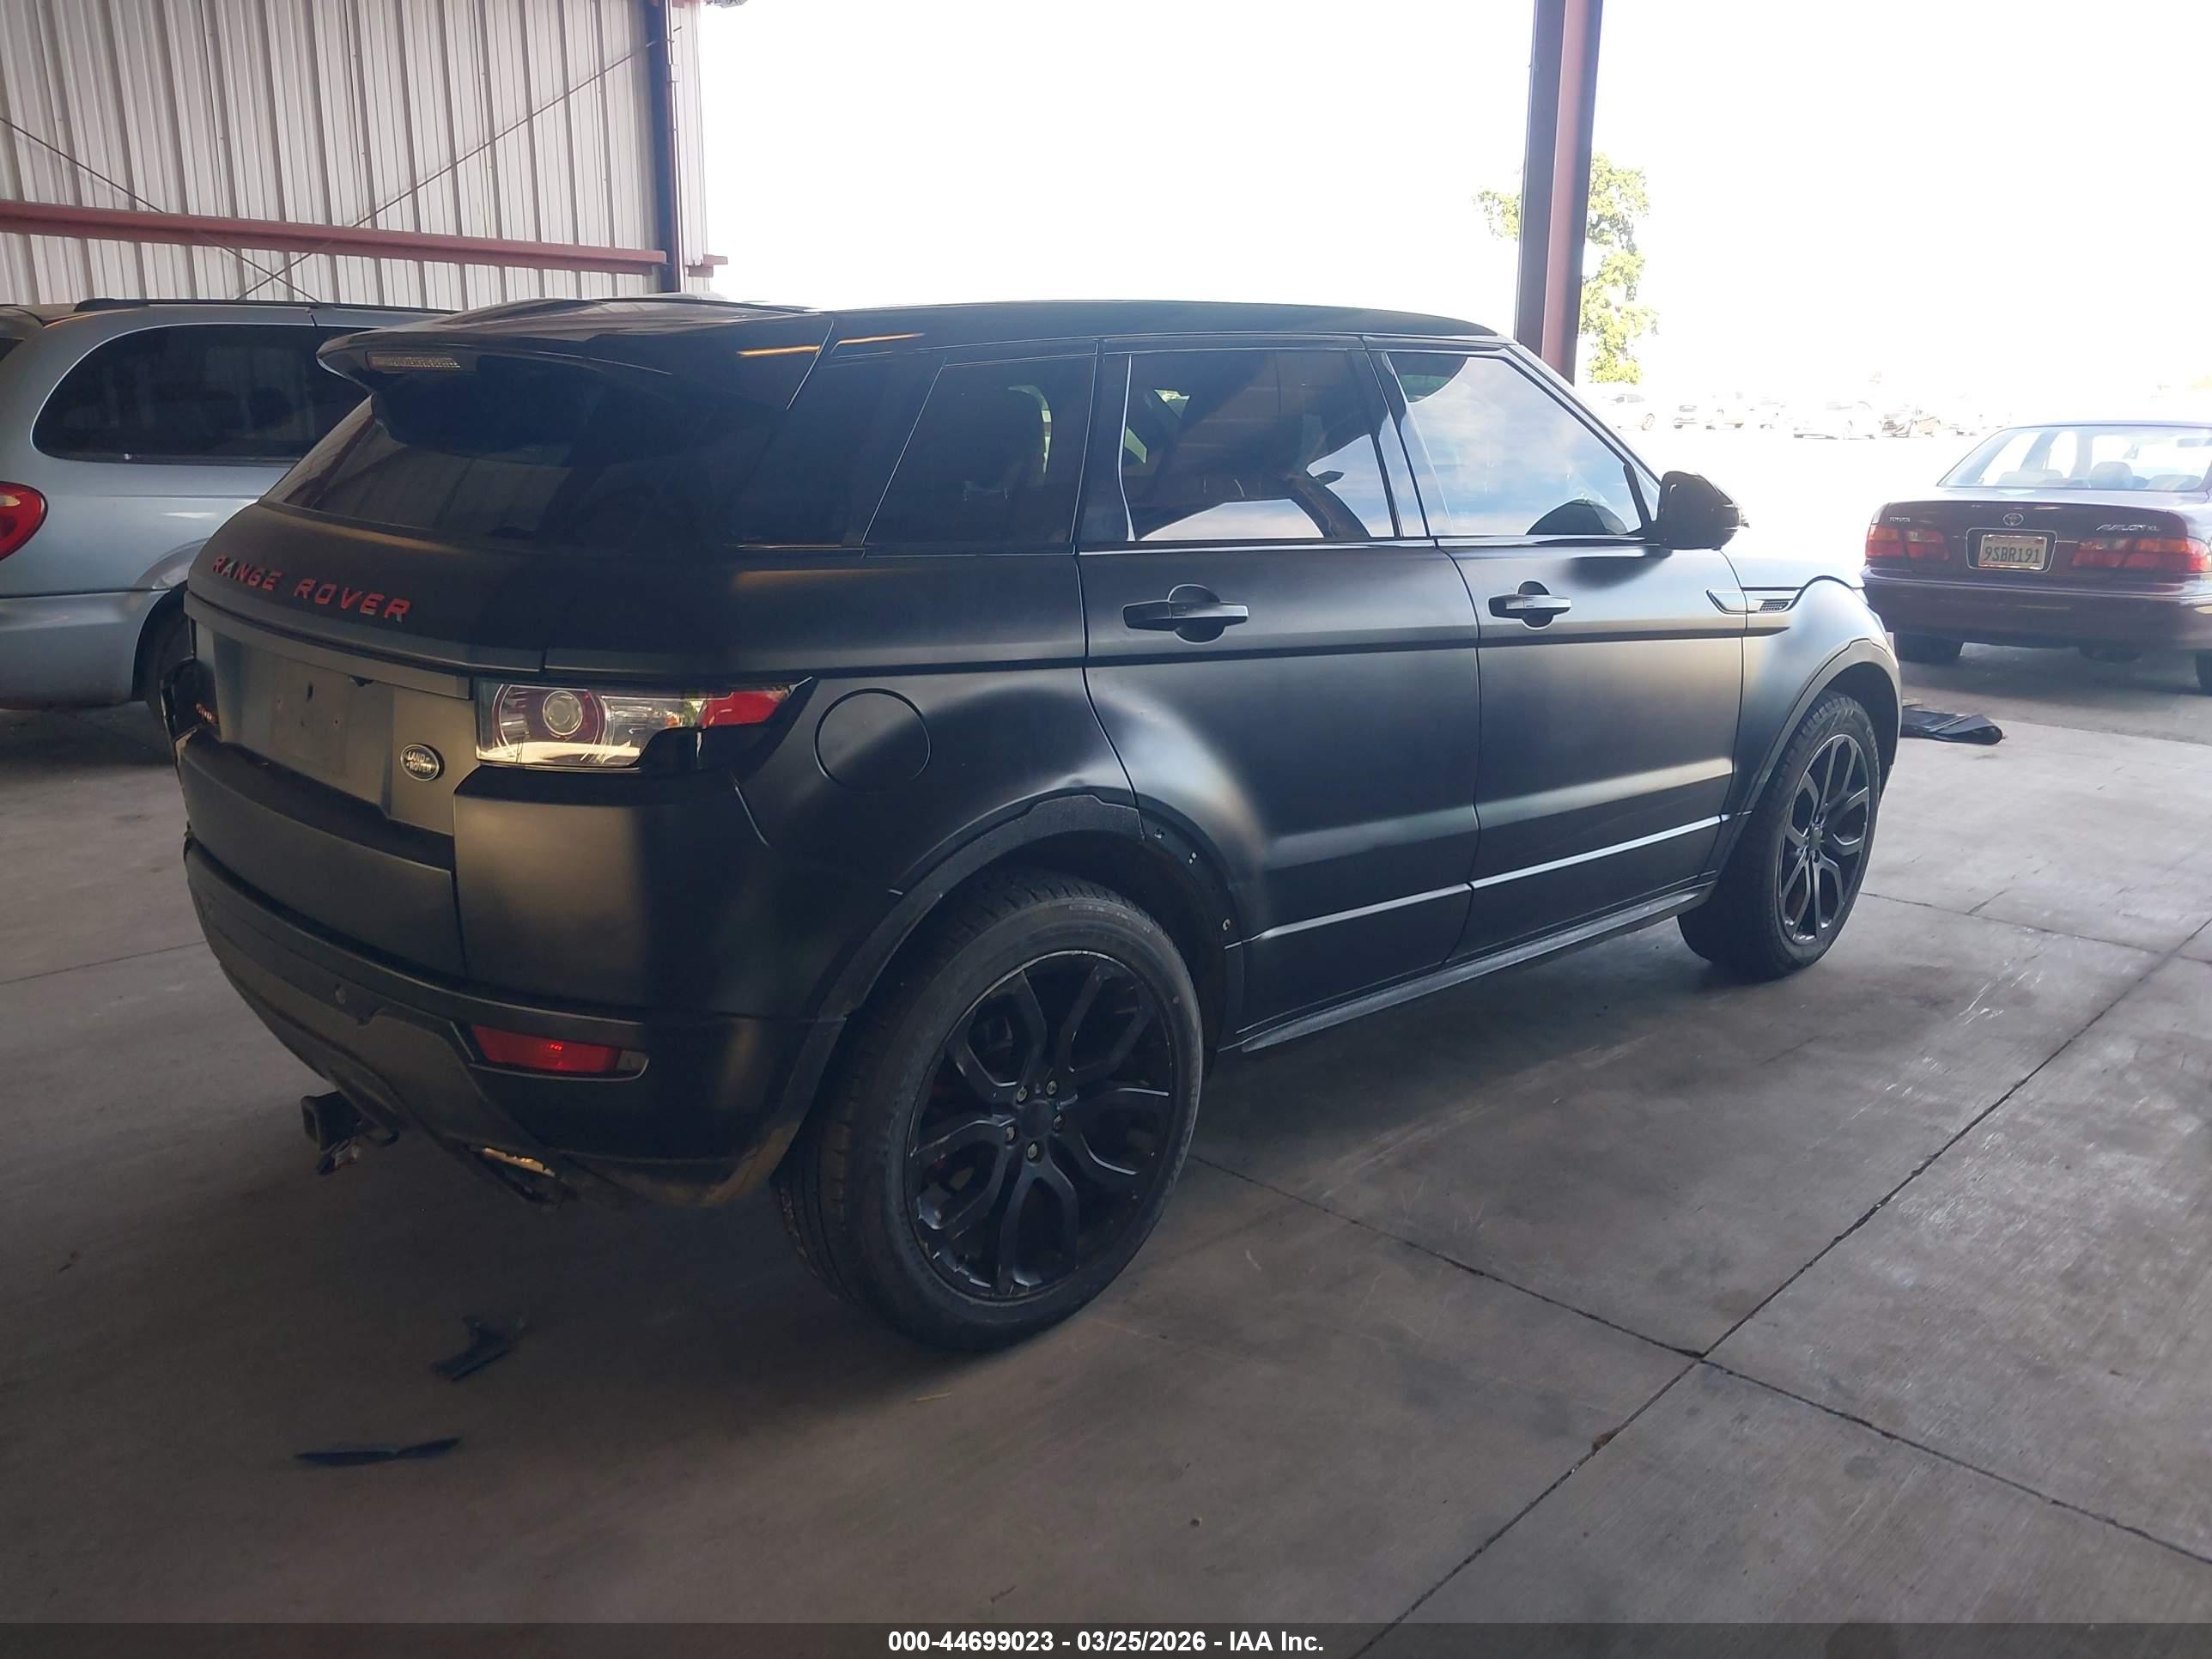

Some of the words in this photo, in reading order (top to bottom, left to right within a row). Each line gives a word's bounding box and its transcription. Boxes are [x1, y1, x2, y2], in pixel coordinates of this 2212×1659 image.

[1984, 546, 2040, 564] 9SBR191
[211, 556, 283, 591] RANGE
[293, 578, 411, 623] ROVER
